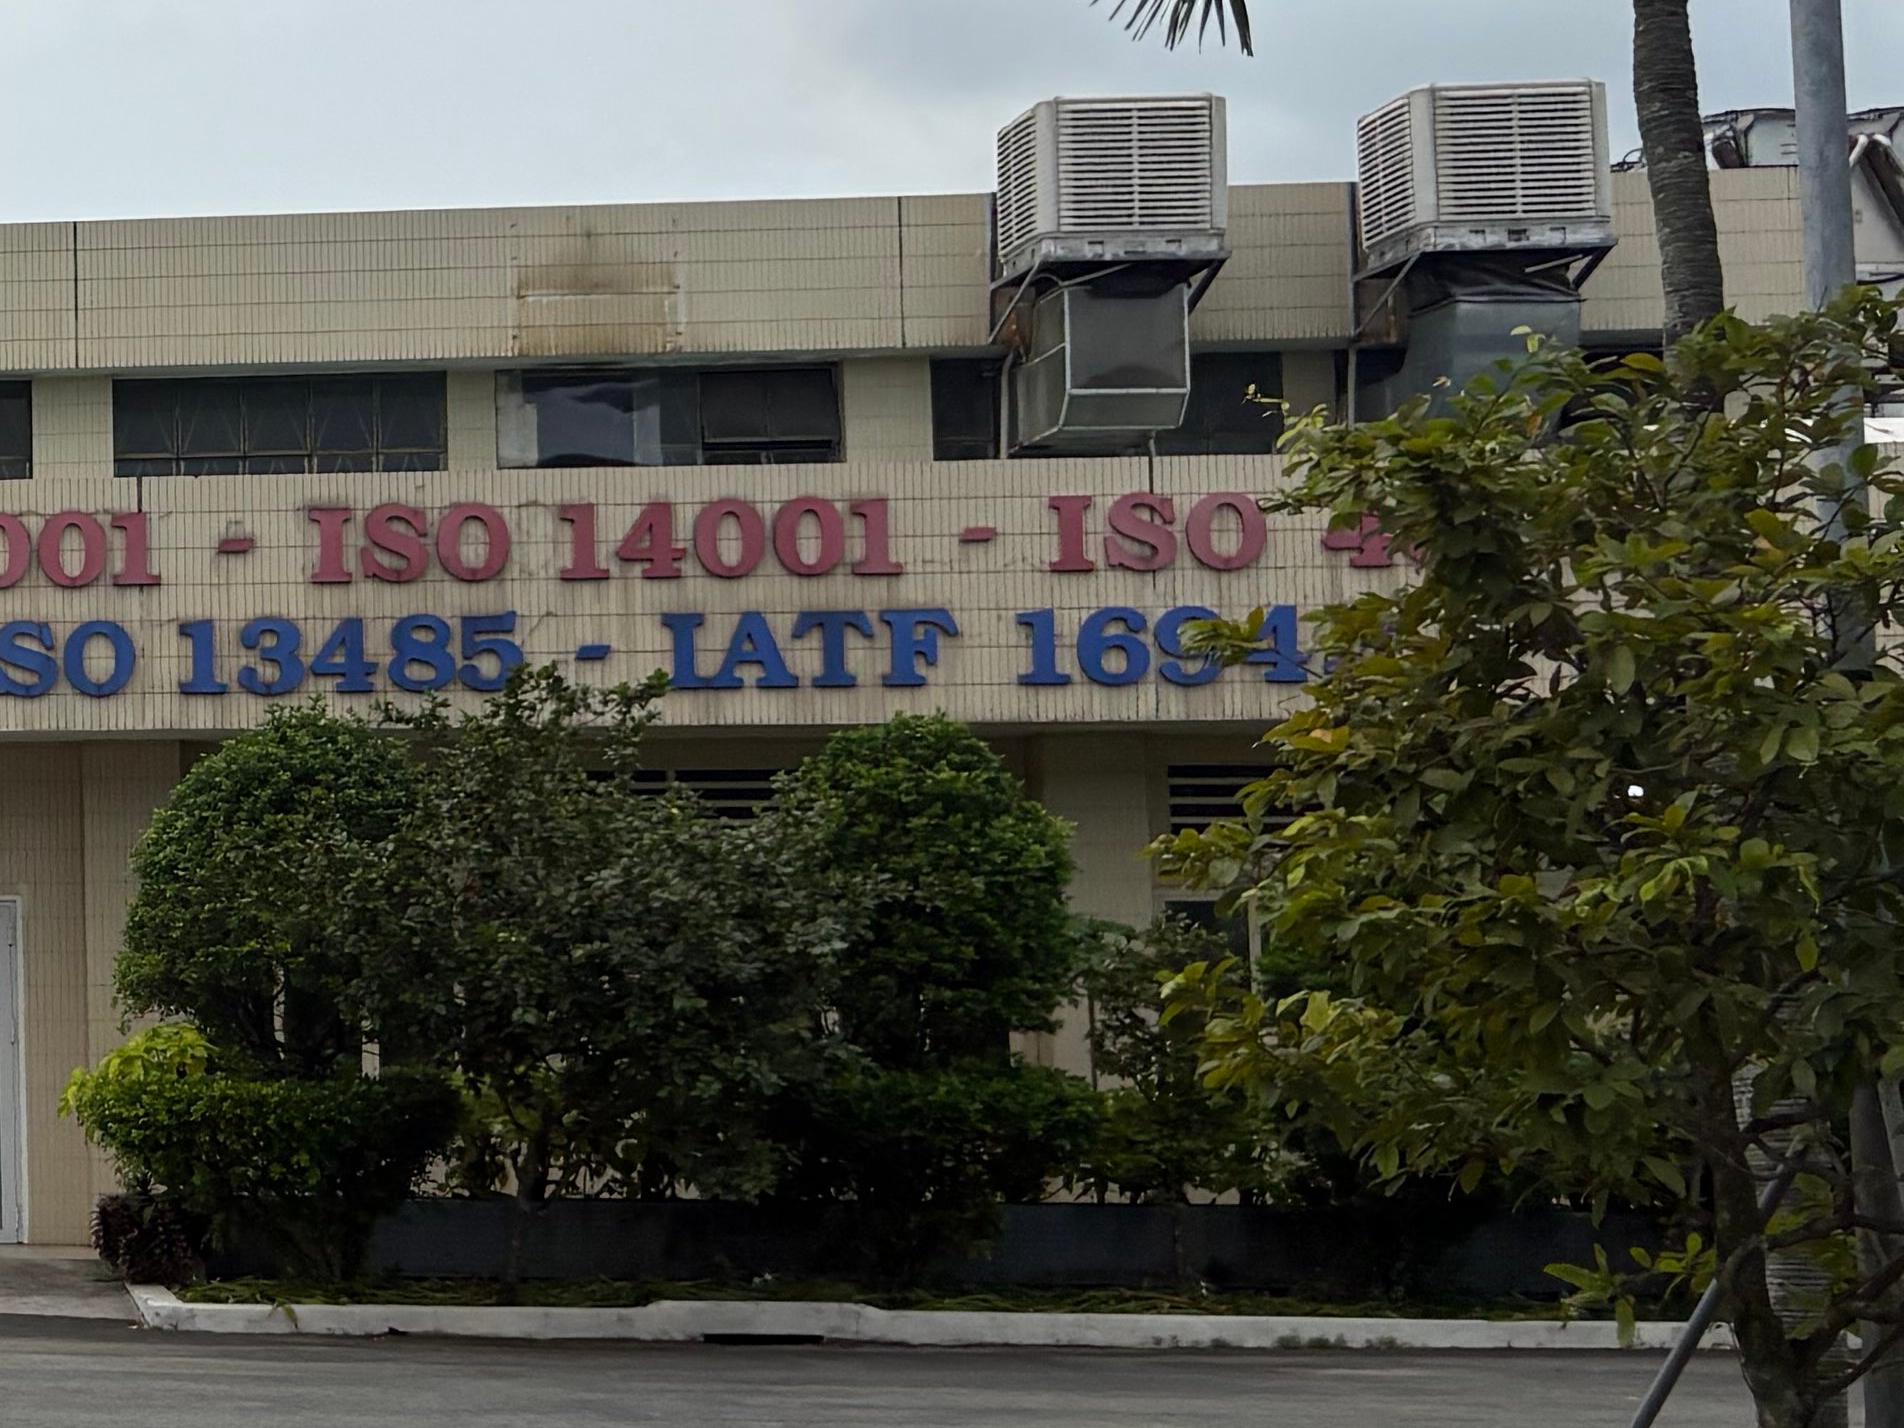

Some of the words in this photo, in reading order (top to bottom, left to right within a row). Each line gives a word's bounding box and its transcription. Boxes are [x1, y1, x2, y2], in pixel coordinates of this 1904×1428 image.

[217, 537, 254, 554] -
[309, 502, 510, 583] ISO
[559, 496, 903, 580] 14001
[959, 526, 997, 542] -
[1048, 492, 1267, 572] ISO
[179, 609, 526, 696] 13485
[574, 644, 610, 660] -
[660, 607, 959, 689] IATF
[1015, 603, 1395, 687] 1694
